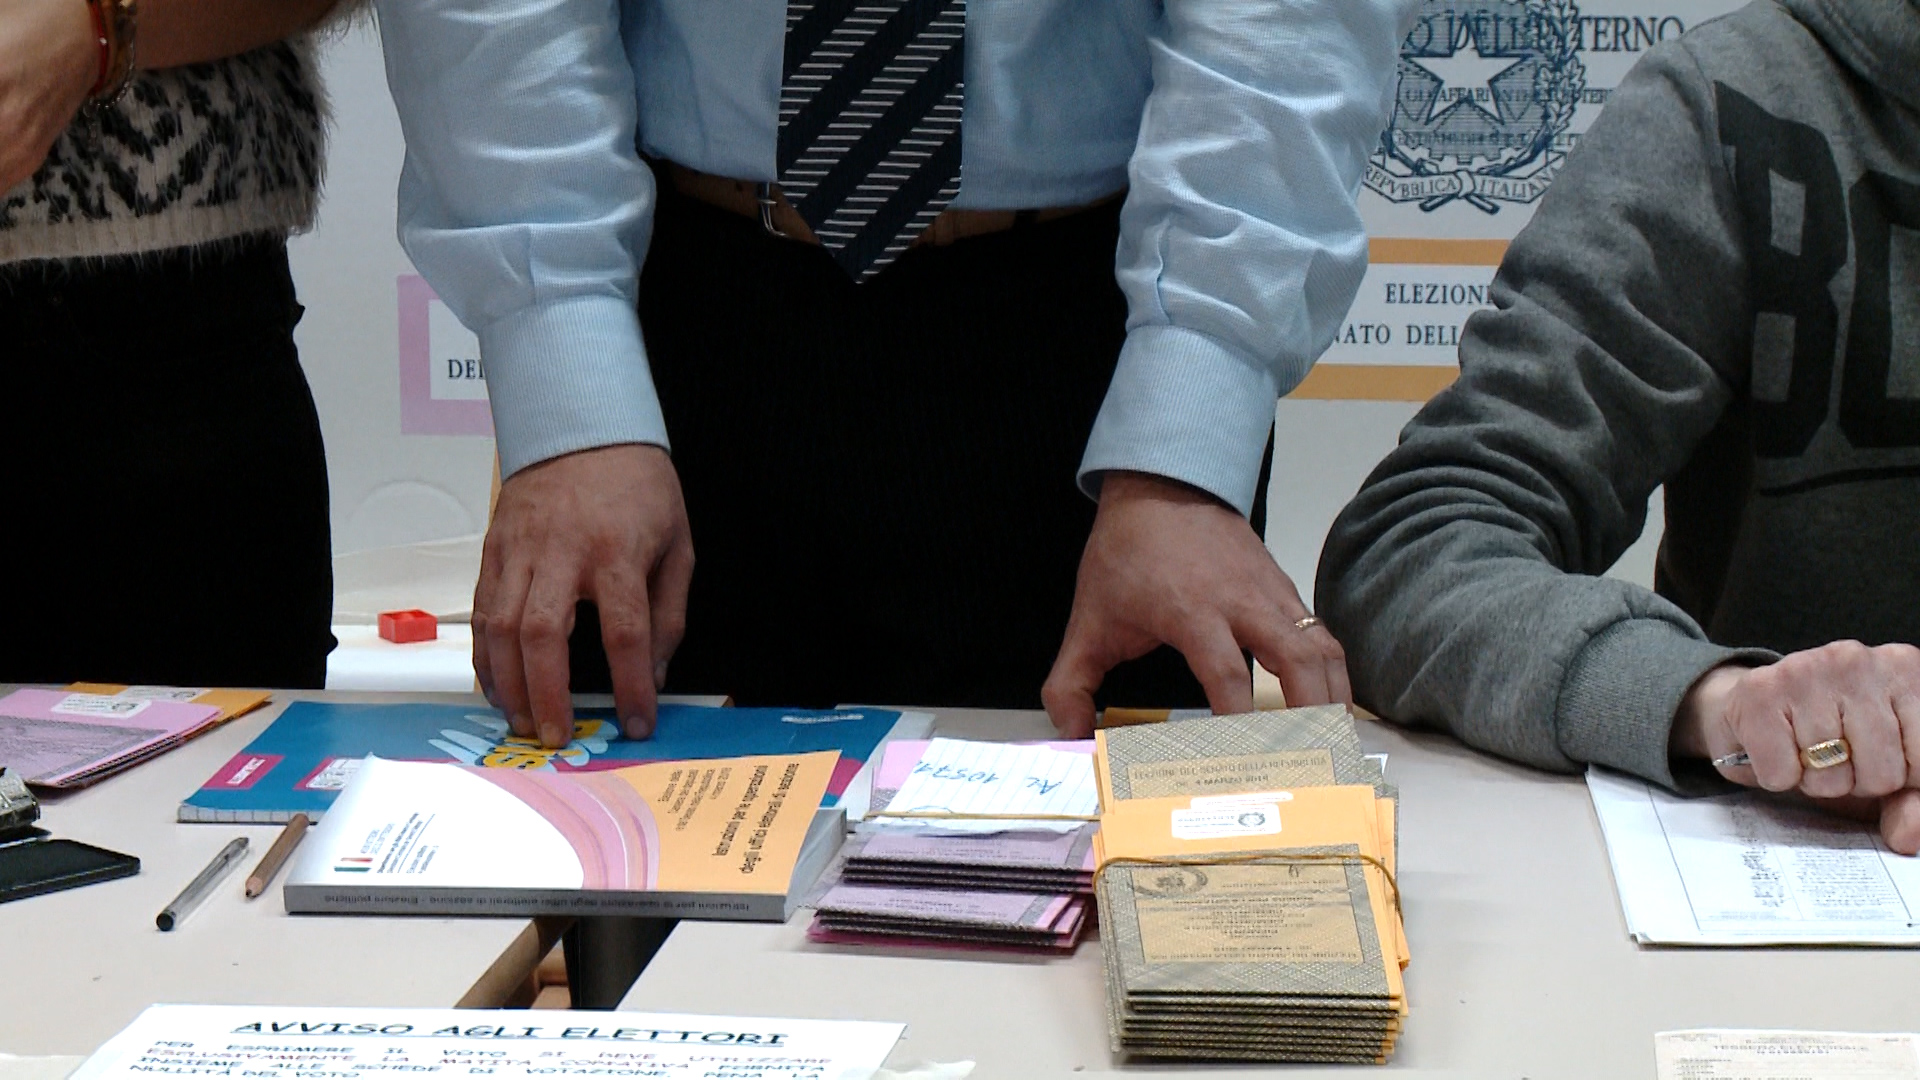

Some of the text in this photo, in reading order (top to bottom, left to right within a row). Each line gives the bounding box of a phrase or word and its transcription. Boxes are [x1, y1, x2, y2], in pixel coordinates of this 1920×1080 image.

[1334, 323, 1391, 345] ATO
[230, 1021, 789, 1045] AVVISO AGLI ELETTORI
[443, 1049, 507, 1058] VOTO
